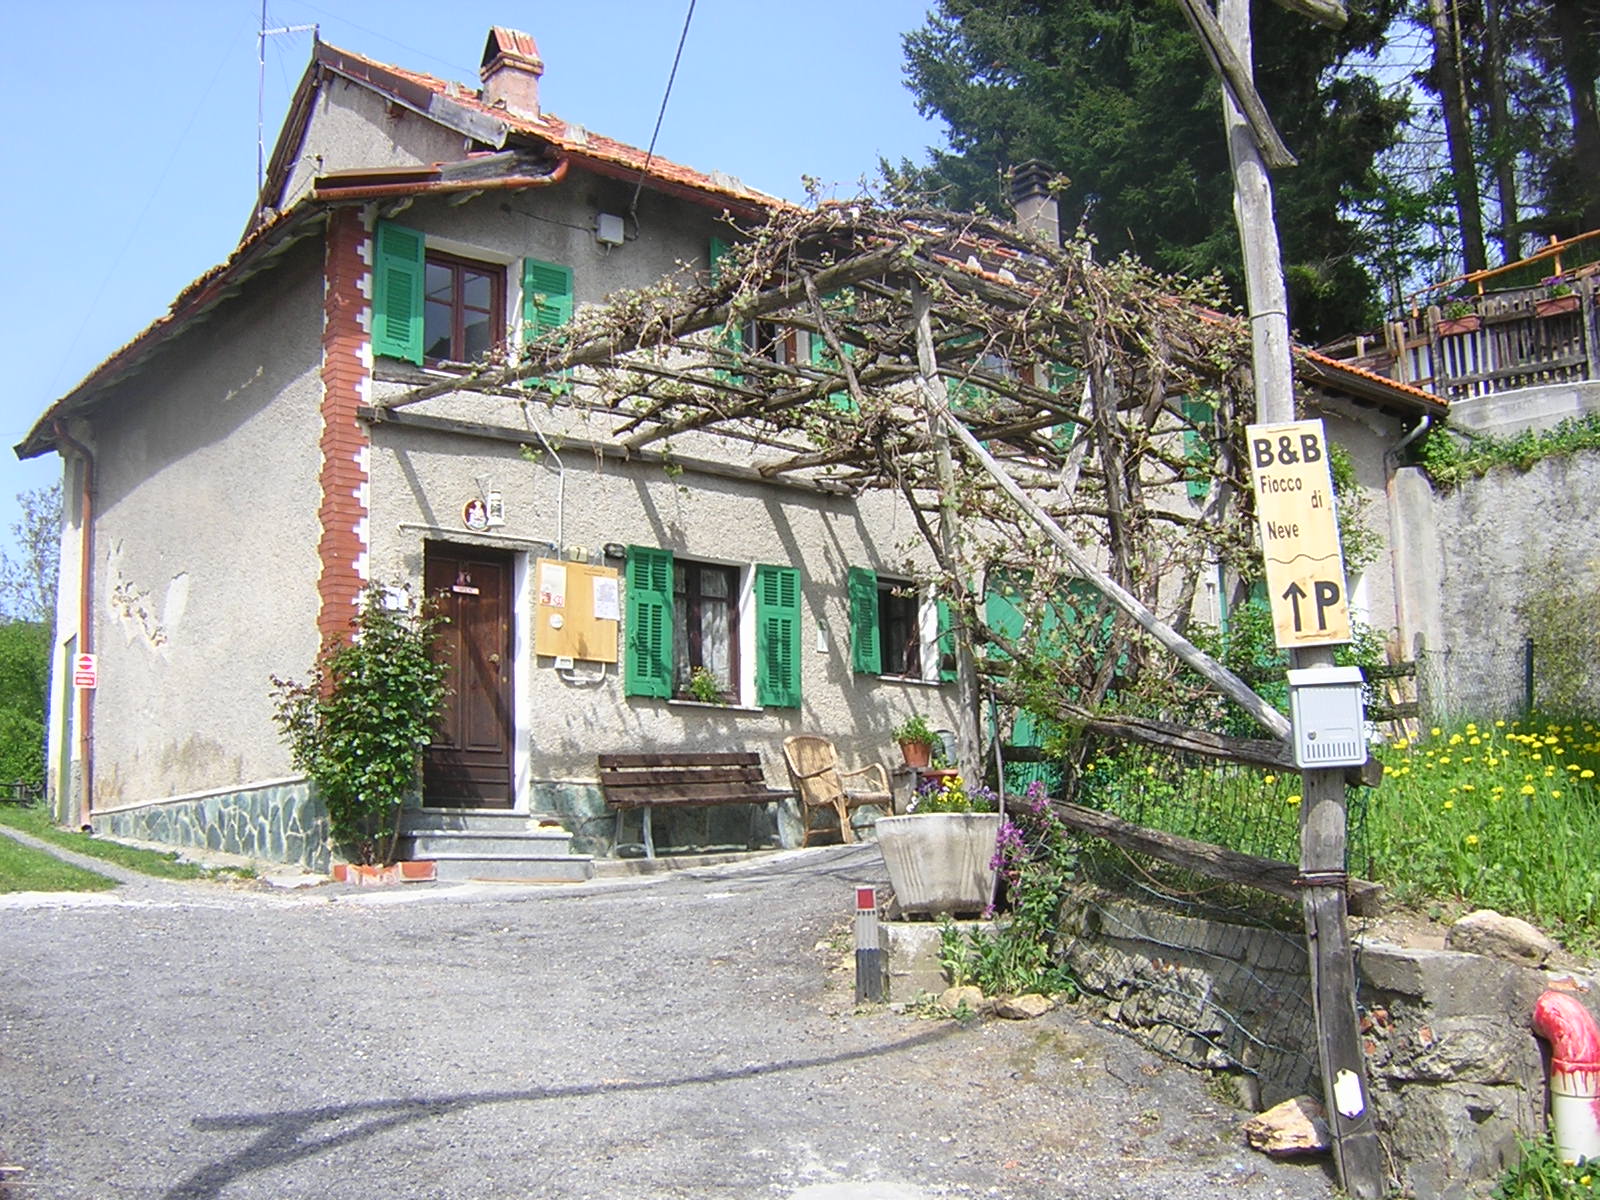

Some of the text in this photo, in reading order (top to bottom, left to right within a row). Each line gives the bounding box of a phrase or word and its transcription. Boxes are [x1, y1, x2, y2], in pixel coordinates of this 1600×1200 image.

[1253, 434, 1321, 468] B&B
[1260, 475, 1302, 494] Fiocco
[1311, 490, 1323, 508] di
[1267, 521, 1299, 540] Neve
[1314, 581, 1340, 630] P
